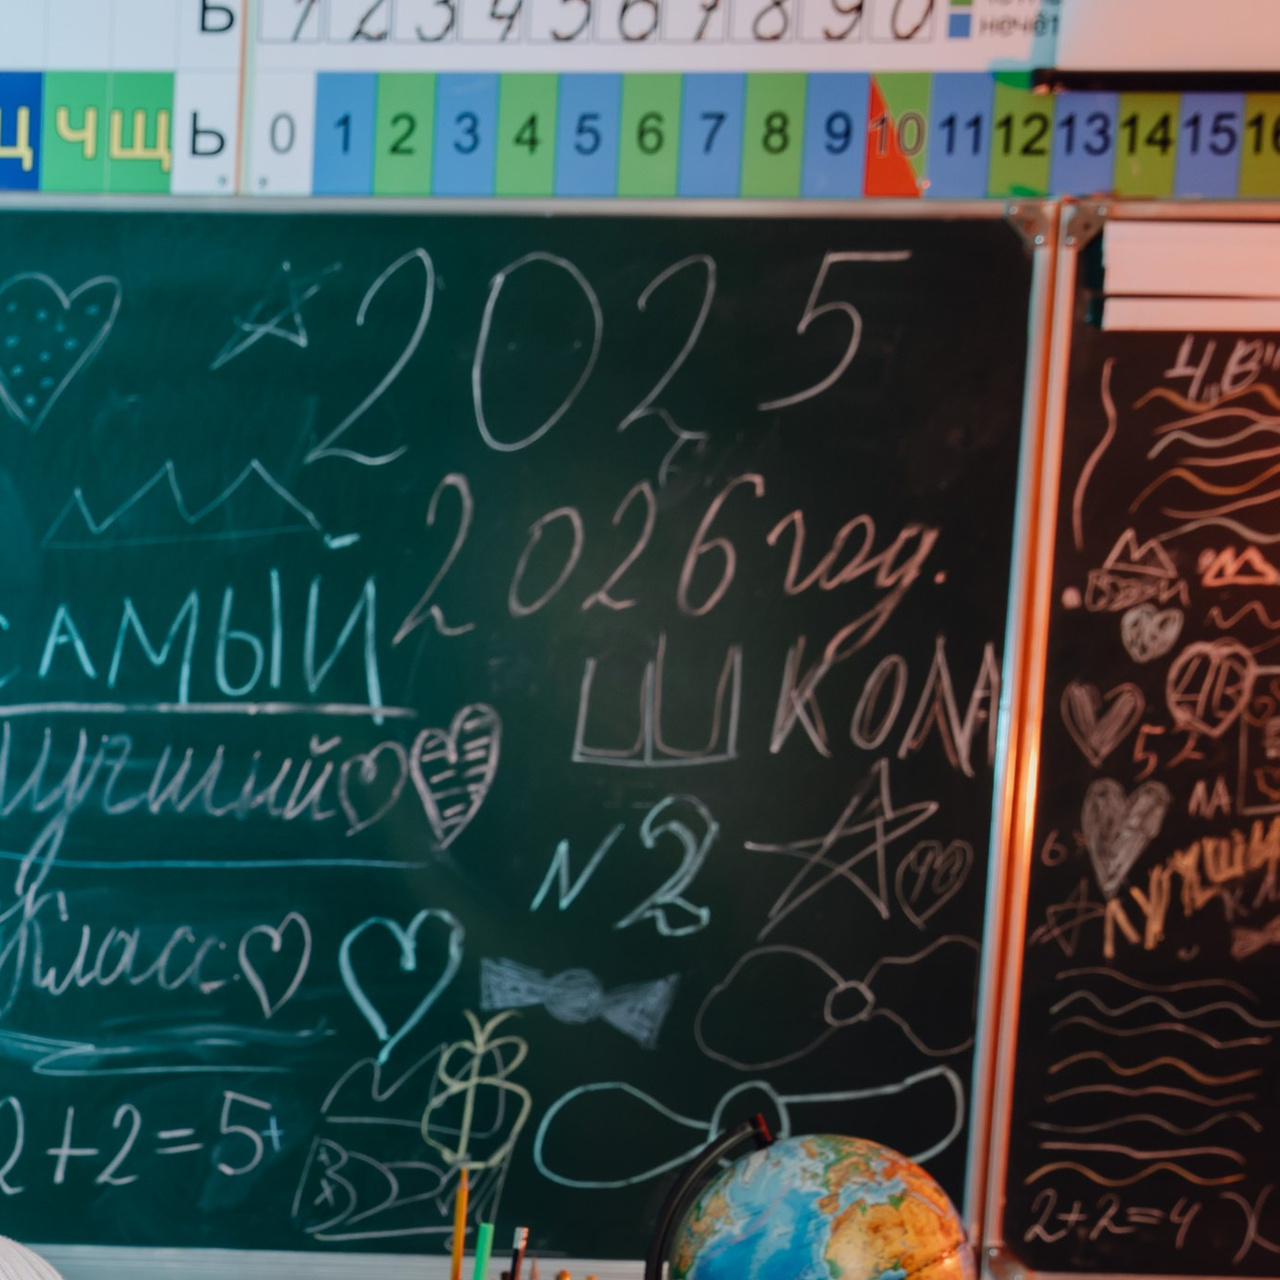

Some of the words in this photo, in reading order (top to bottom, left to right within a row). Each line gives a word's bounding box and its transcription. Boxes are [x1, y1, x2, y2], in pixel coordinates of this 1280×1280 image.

[270, 112, 296, 155] 0
[333, 112, 352, 155] 1
[390, 112, 417, 155] 2
[453, 112, 481, 155] 3
[514, 112, 540, 155] 4
[574, 112, 602, 155] 5
[637, 112, 665, 155] 6
[699, 112, 728, 155] 7
[762, 112, 790, 155] 8
[824, 112, 853, 155] 9
[870, 112, 927, 155] 10
[939, 112, 984, 155] 11
[995, 112, 1051, 155] 12
[1057, 112, 1112, 155] 13
[1120, 112, 1174, 155] 14
[1182, 112, 1238, 155] 15
[1246, 112, 1280, 155] 1
[304, 247, 912, 465] 2025
[392, 473, 766, 646] 2026
